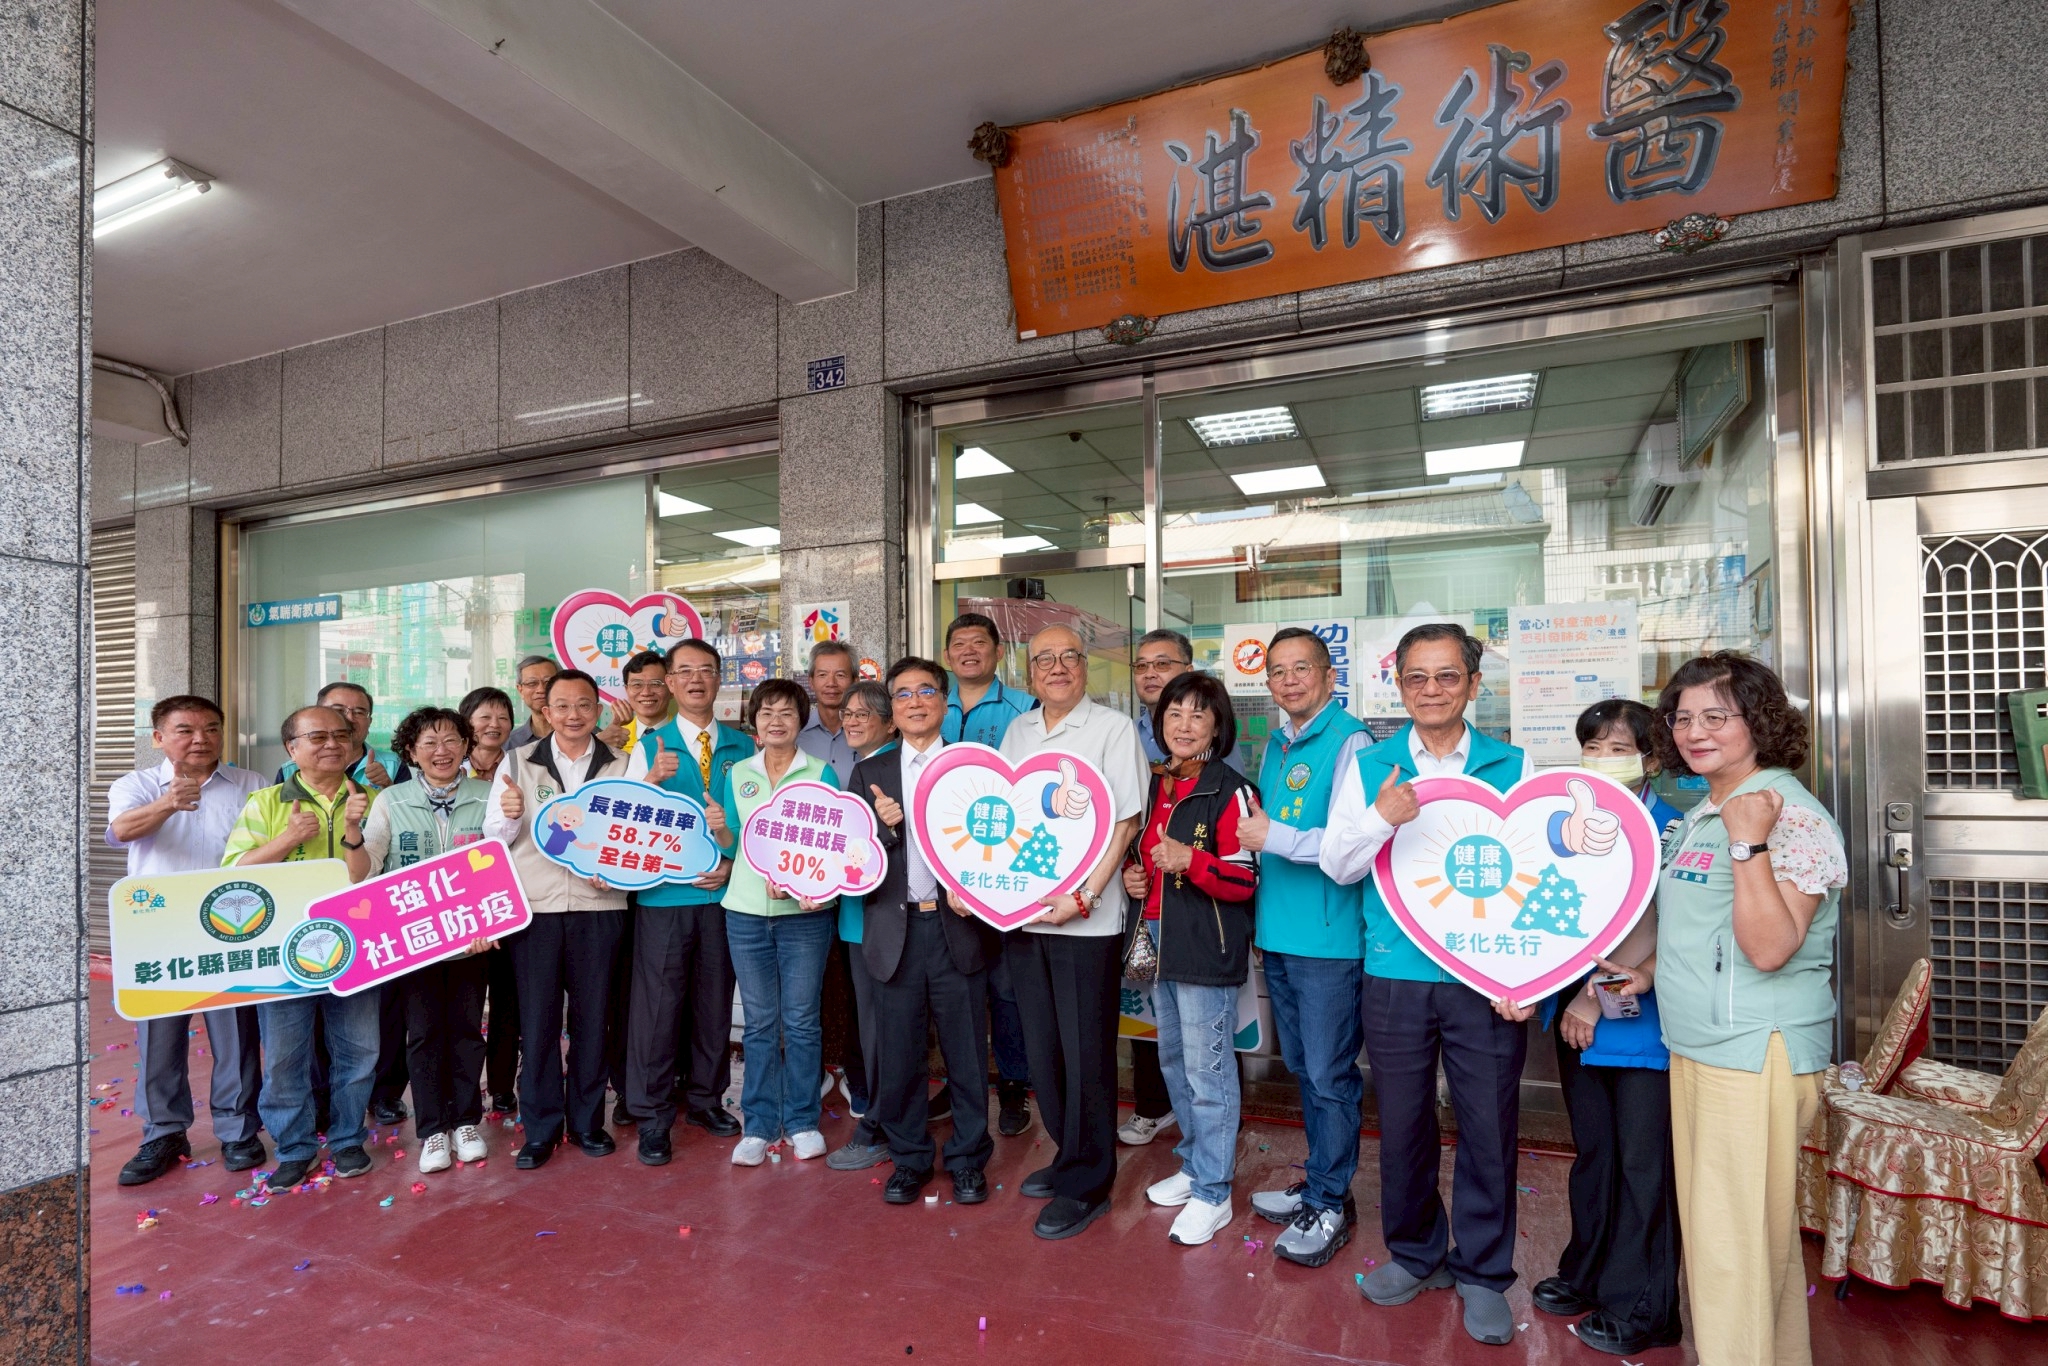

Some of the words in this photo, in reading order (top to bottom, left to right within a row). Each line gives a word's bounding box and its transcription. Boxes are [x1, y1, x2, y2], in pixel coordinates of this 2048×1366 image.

[816, 368, 844, 389] 342
[601, 629, 629, 640] 健康
[601, 641, 629, 653] 台灣
[595, 675, 626, 687] 彰化
[587, 793, 697, 833] 長者接種率
[781, 798, 844, 828] 深耕院所
[972, 800, 1011, 820] 健康
[606, 824, 682, 854] 58.7%
[754, 818, 848, 855] 疫苗接種成長
[972, 820, 1011, 840] 台灣
[598, 845, 684, 877] 全台第一
[1453, 843, 1502, 866] 健康
[777, 854, 825, 882] 30%
[1453, 866, 1502, 889] 台灣
[386, 865, 466, 917] 強化
[959, 871, 1029, 893] 彰化先行
[219, 934, 251, 942] MEDICAL
[361, 888, 519, 971] 社區防疫
[1444, 930, 1543, 957] 彰化先行
[134, 945, 281, 985] 彰化縣醫師
[310, 969, 338, 979] MEDICAL
